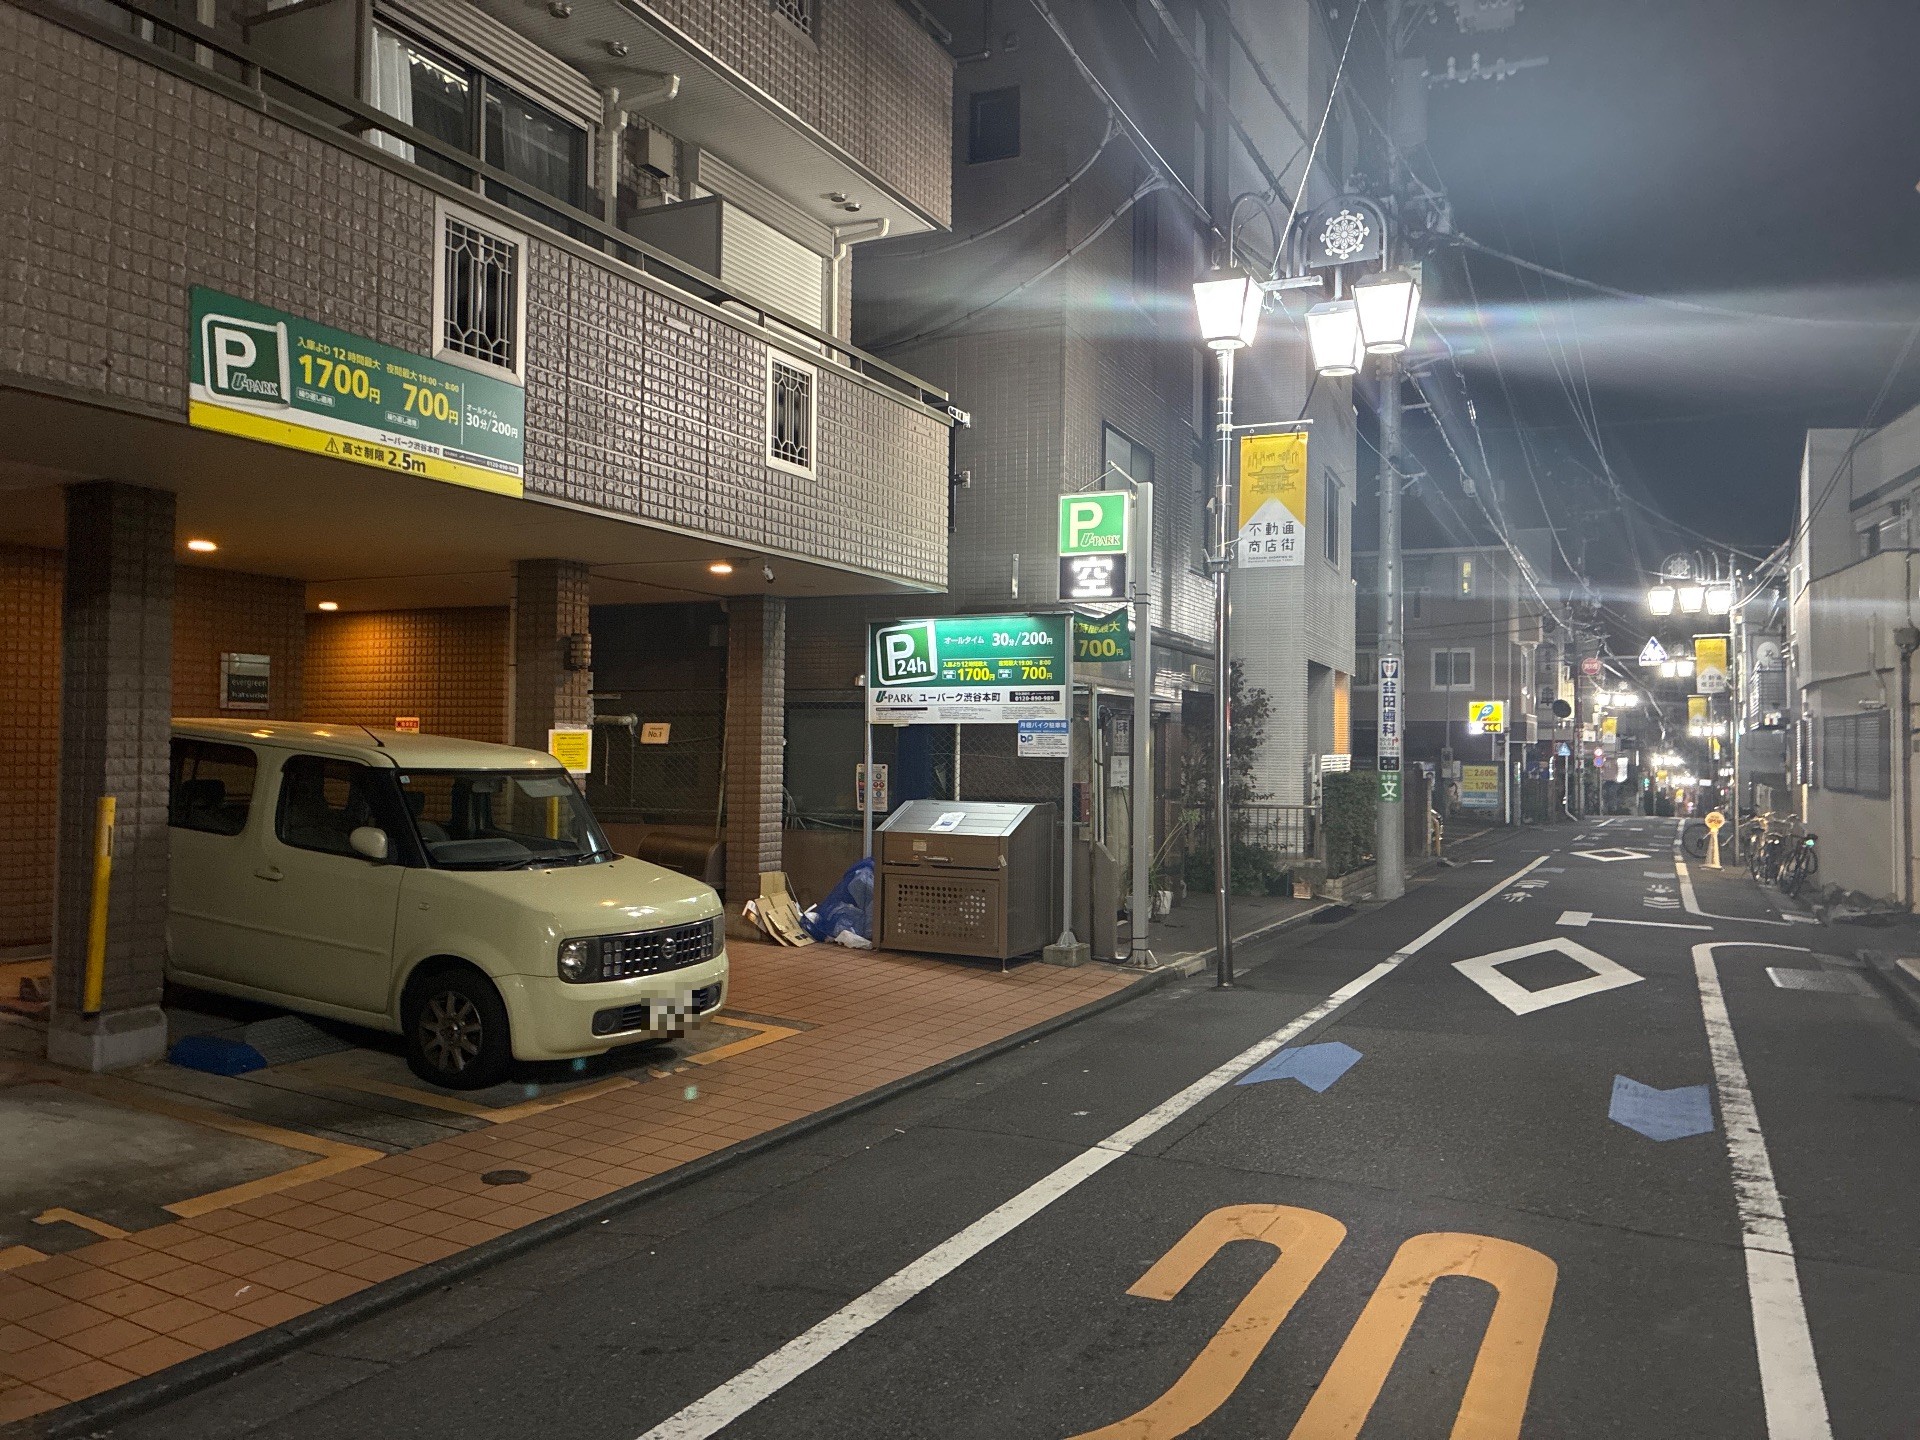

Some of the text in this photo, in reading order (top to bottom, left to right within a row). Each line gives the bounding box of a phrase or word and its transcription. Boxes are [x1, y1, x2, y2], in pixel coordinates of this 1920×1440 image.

[214, 326, 257, 389] P
[298, 354, 381, 404] 1700円
[402, 383, 459, 426] 700円
[466, 403, 498, 418] オールタイム
[465, 412, 518, 439] 30分/200円
[380, 433, 440, 456] ユーパーク渋谷本町
[342, 441, 385, 462] 高さ制限
[387, 450, 426, 473] 2.5m
[1069, 501, 1104, 548] P
[1248, 520, 1294, 536] 不動通
[1248, 538, 1294, 553] 商店街
[1072, 556, 1113, 598] 空
[944, 631, 1053, 647] オールタイム 30分/200円
[1075, 638, 1124, 657] 700円
[886, 633, 915, 677] P
[896, 656, 926, 676] 24h
[957, 668, 996, 681] 1700円
[1021, 666, 1053, 680] 700円
[876, 690, 914, 703] U-PARK
[918, 692, 1001, 702] ユーパーク渋谷本町
[1382, 681, 1396, 737] 金田歯科
[1382, 780, 1398, 798] 文
